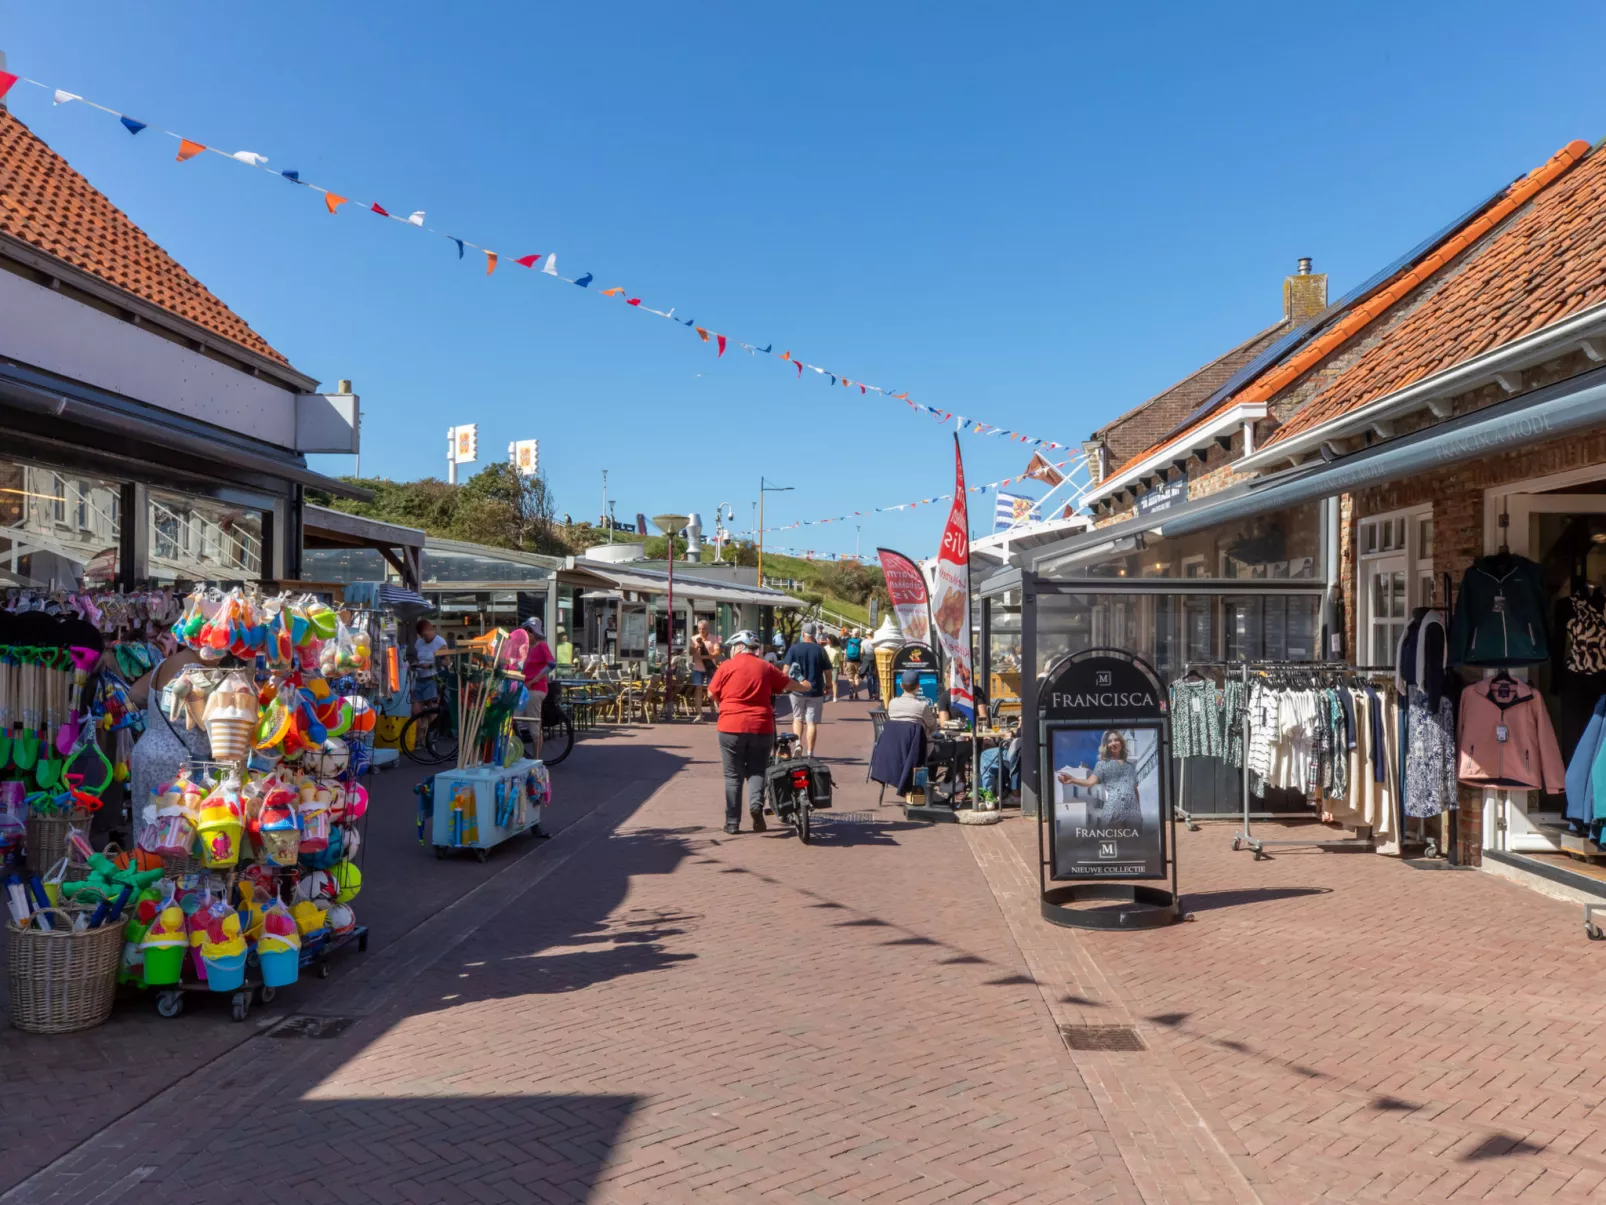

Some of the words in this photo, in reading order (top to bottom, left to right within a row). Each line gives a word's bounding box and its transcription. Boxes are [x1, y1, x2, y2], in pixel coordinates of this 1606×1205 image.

[1436, 428, 1505, 460] FRANCISCA
[1506, 412, 1553, 440] MODE
[1052, 692, 1154, 708] FRANCISCA
[1075, 827, 1139, 838] FRANCISCA
[1071, 866, 1103, 874] NIEUWE
[1103, 865, 1146, 873] COLLECTIE
